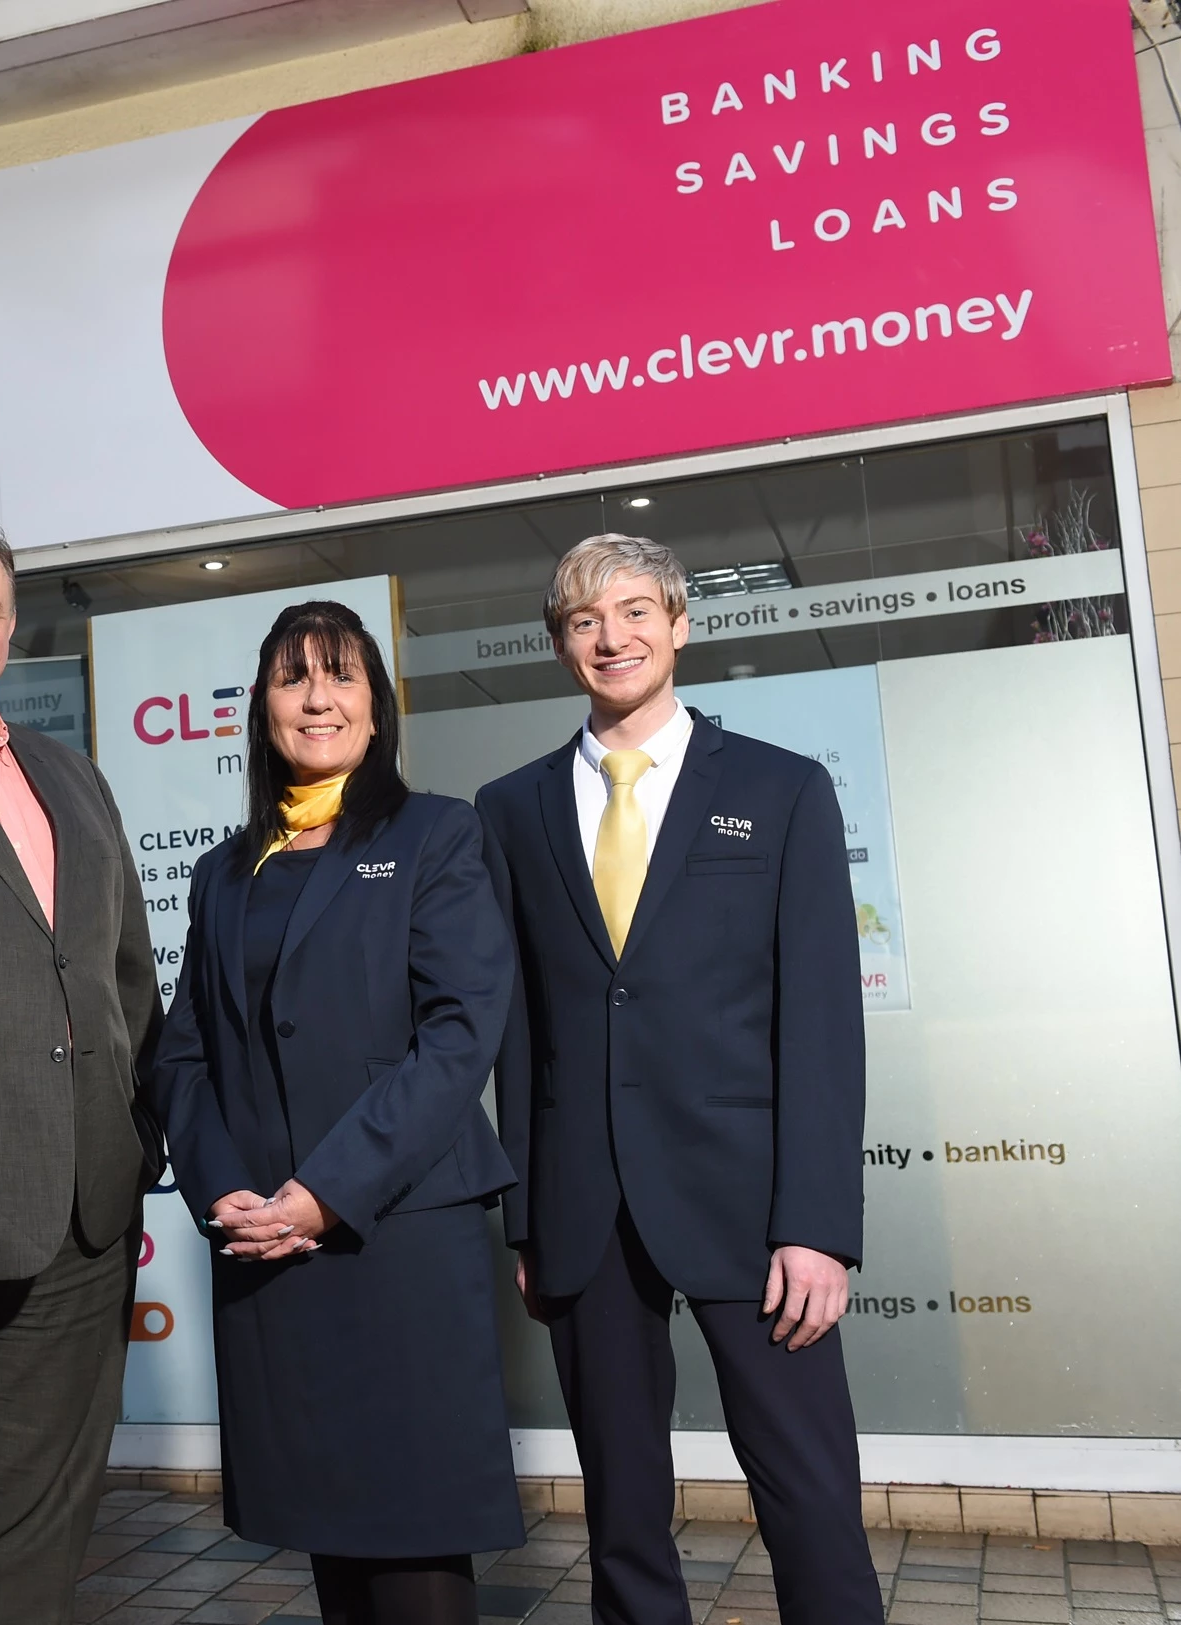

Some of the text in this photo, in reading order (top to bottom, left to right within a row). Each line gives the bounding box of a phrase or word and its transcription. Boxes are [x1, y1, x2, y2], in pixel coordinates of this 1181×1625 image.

[662, 28, 1001, 125] BANKING
[676, 102, 1010, 194] SAVINGS
[771, 177, 1018, 251] LOANS
[478, 289, 1033, 411] www.clevr.money
[809, 591, 916, 620] savings
[948, 577, 1026, 602] loans
[477, 632, 553, 659] banki
[133, 686, 257, 745] CLE
[710, 815, 753, 831] CLEVR
[717, 827, 751, 840] money
[140, 828, 215, 851] CLEVR
[141, 864, 158, 882] is
[357, 861, 396, 873] CLEVR
[362, 871, 394, 879] money
[945, 1138, 1066, 1165] banking
[950, 1291, 1032, 1314] loans
